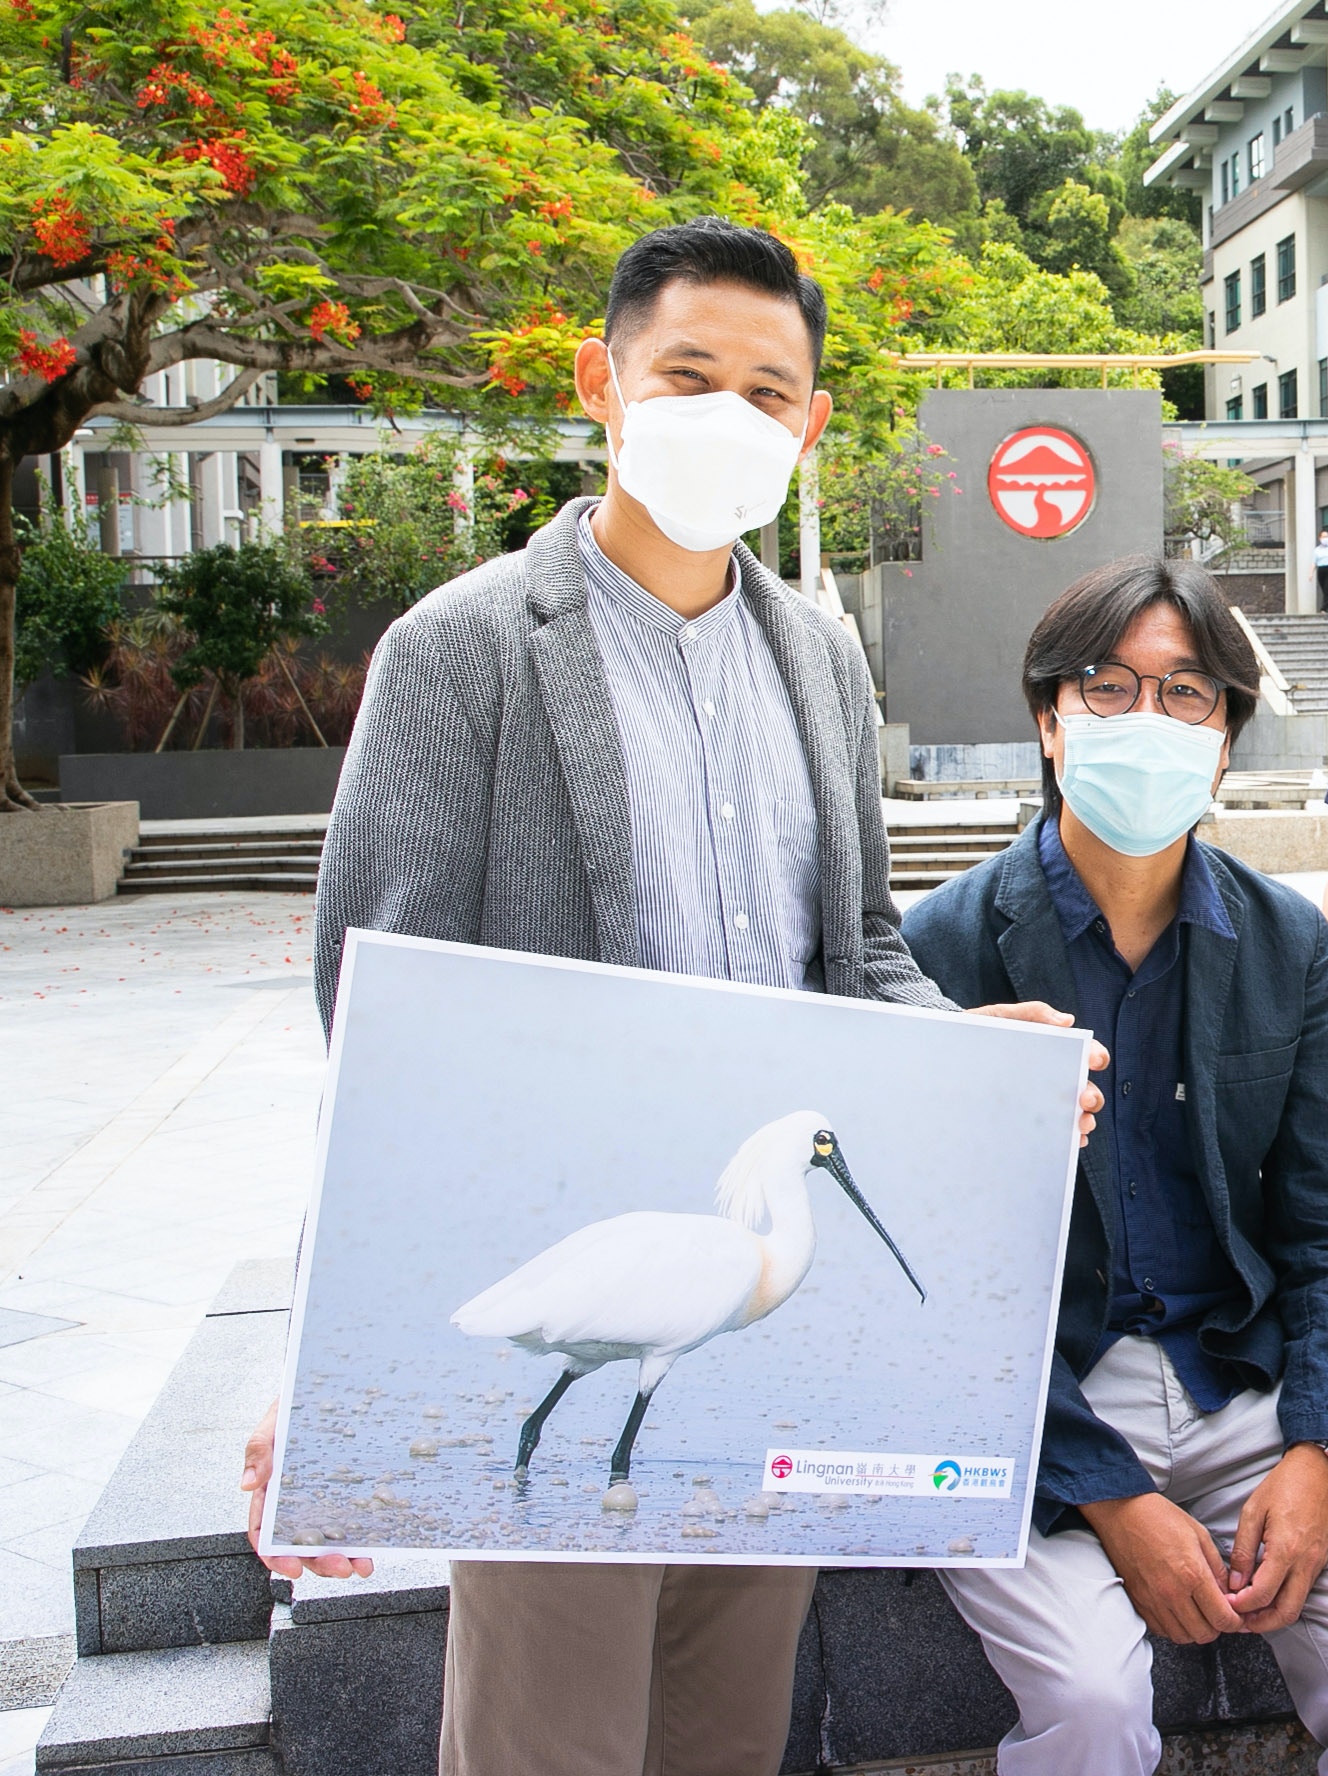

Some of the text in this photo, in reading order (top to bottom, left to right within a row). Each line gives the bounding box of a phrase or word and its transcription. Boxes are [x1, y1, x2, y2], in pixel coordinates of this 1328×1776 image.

[796, 1460, 853, 1477] Lingnan
[964, 1467, 1007, 1477] HKBWS
[825, 1476, 873, 1488] University
